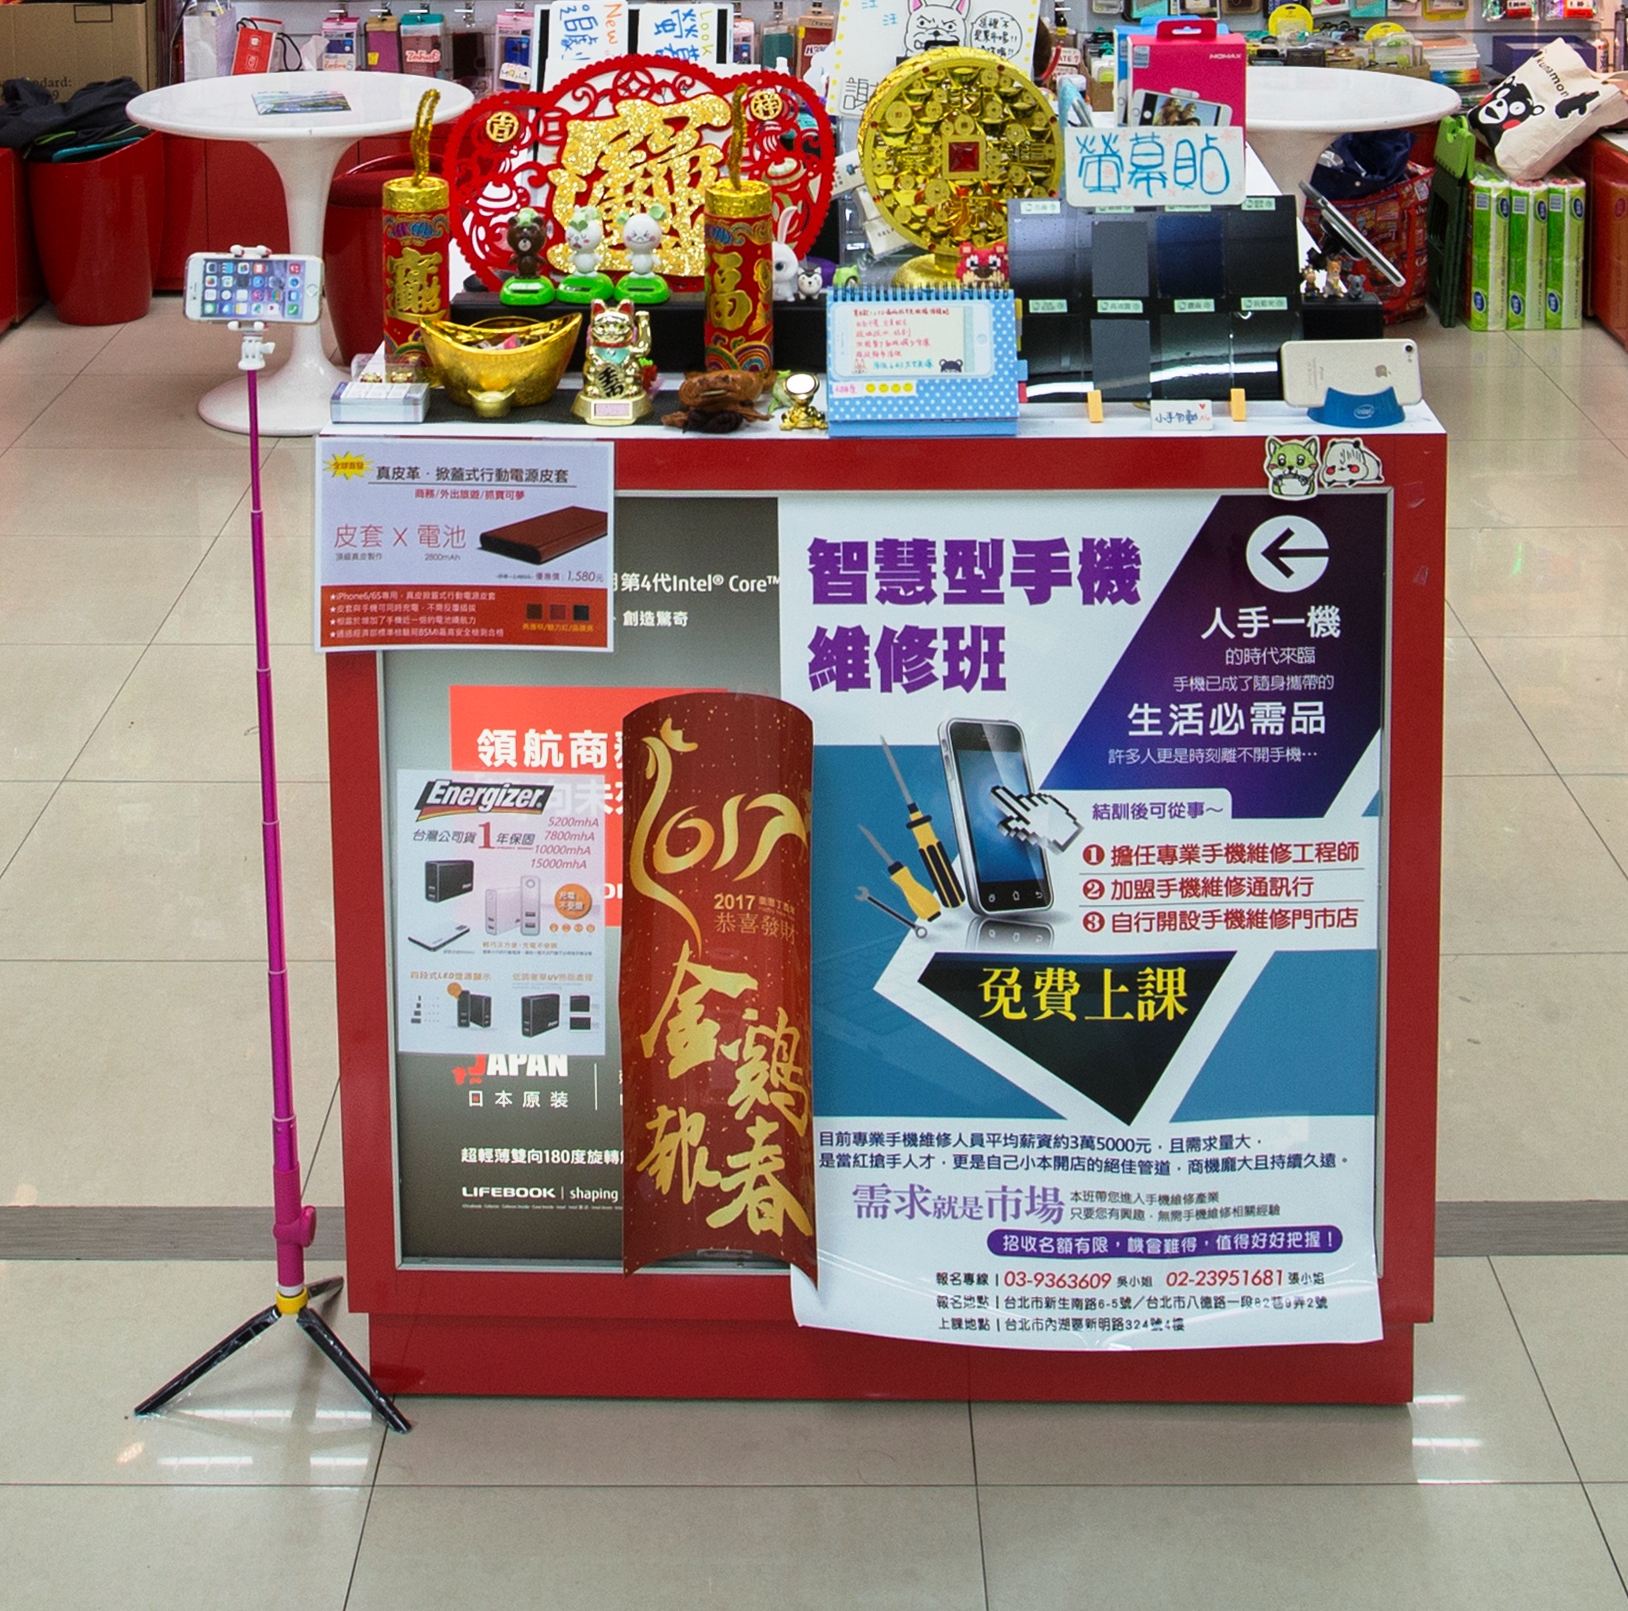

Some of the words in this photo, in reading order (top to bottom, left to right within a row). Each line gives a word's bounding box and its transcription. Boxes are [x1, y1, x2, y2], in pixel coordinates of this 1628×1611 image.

[1075, 132, 1231, 199] 螢幕貼
[333, 524, 384, 549] 皮套
[417, 524, 467, 549] 電池
[424, 553, 461, 562] 2800mAh
[808, 536, 1142, 607] 智慧型手機
[1201, 604, 1342, 641] 人手一機
[808, 624, 1007, 692] 維修班
[1224, 646, 1316, 667] 的時代來臨
[1127, 700, 1328, 738] 生活必需品
[1110, 841, 1359, 867] 擔任專業手機維修工程師
[1110, 875, 1315, 901] 加盟手機維修通訊行
[713, 892, 756, 911] 2017
[713, 911, 795, 946] 恭喜發財
[1111, 907, 1358, 934] 自行開設手機維修門市店
[978, 966, 1188, 1024] 免費上課
[460, 1147, 623, 1166] 超輕薄雙向180度旋轉
[461, 1186, 556, 1198] LIFEBOOK
[569, 1188, 619, 1204] shaping
[852, 1182, 1065, 1225] 需求就是市場
[936, 1271, 990, 1288] 報名專線
[1004, 1269, 1113, 1289] 03-9363609
[1165, 1268, 1284, 1289] 02-23951681
